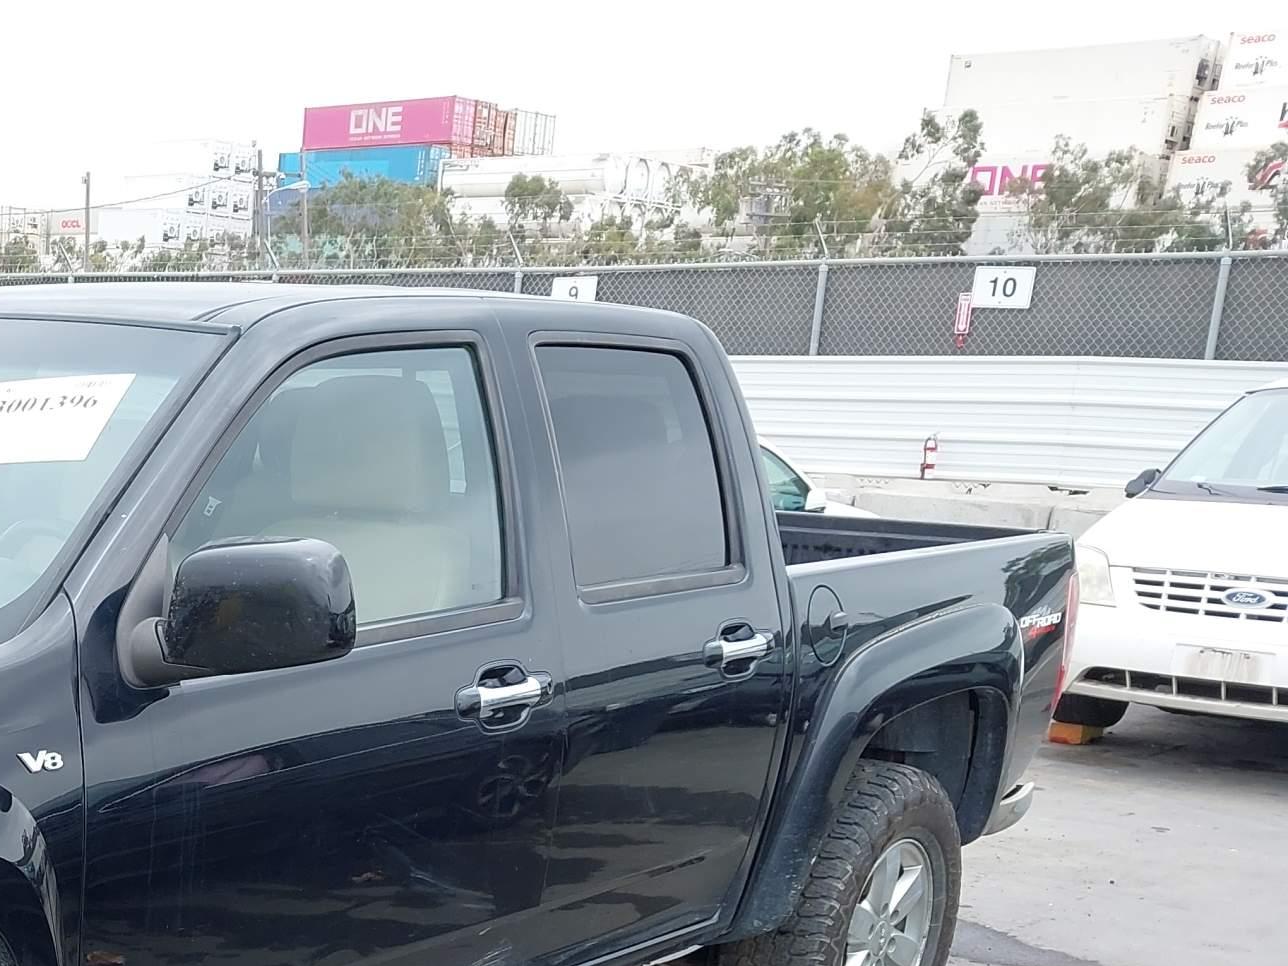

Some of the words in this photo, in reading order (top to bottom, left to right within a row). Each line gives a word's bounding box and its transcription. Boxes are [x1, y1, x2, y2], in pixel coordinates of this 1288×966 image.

[1240, 34, 1276, 45] seaco
[1210, 95, 1246, 105] seaco
[349, 106, 403, 134] ONE
[1181, 155, 1216, 165] seaco
[568, 286, 579, 300] 9
[989, 276, 1017, 297] 10
[1232, 592, 1261, 604] Ford
[15, 750, 64, 774] V8
